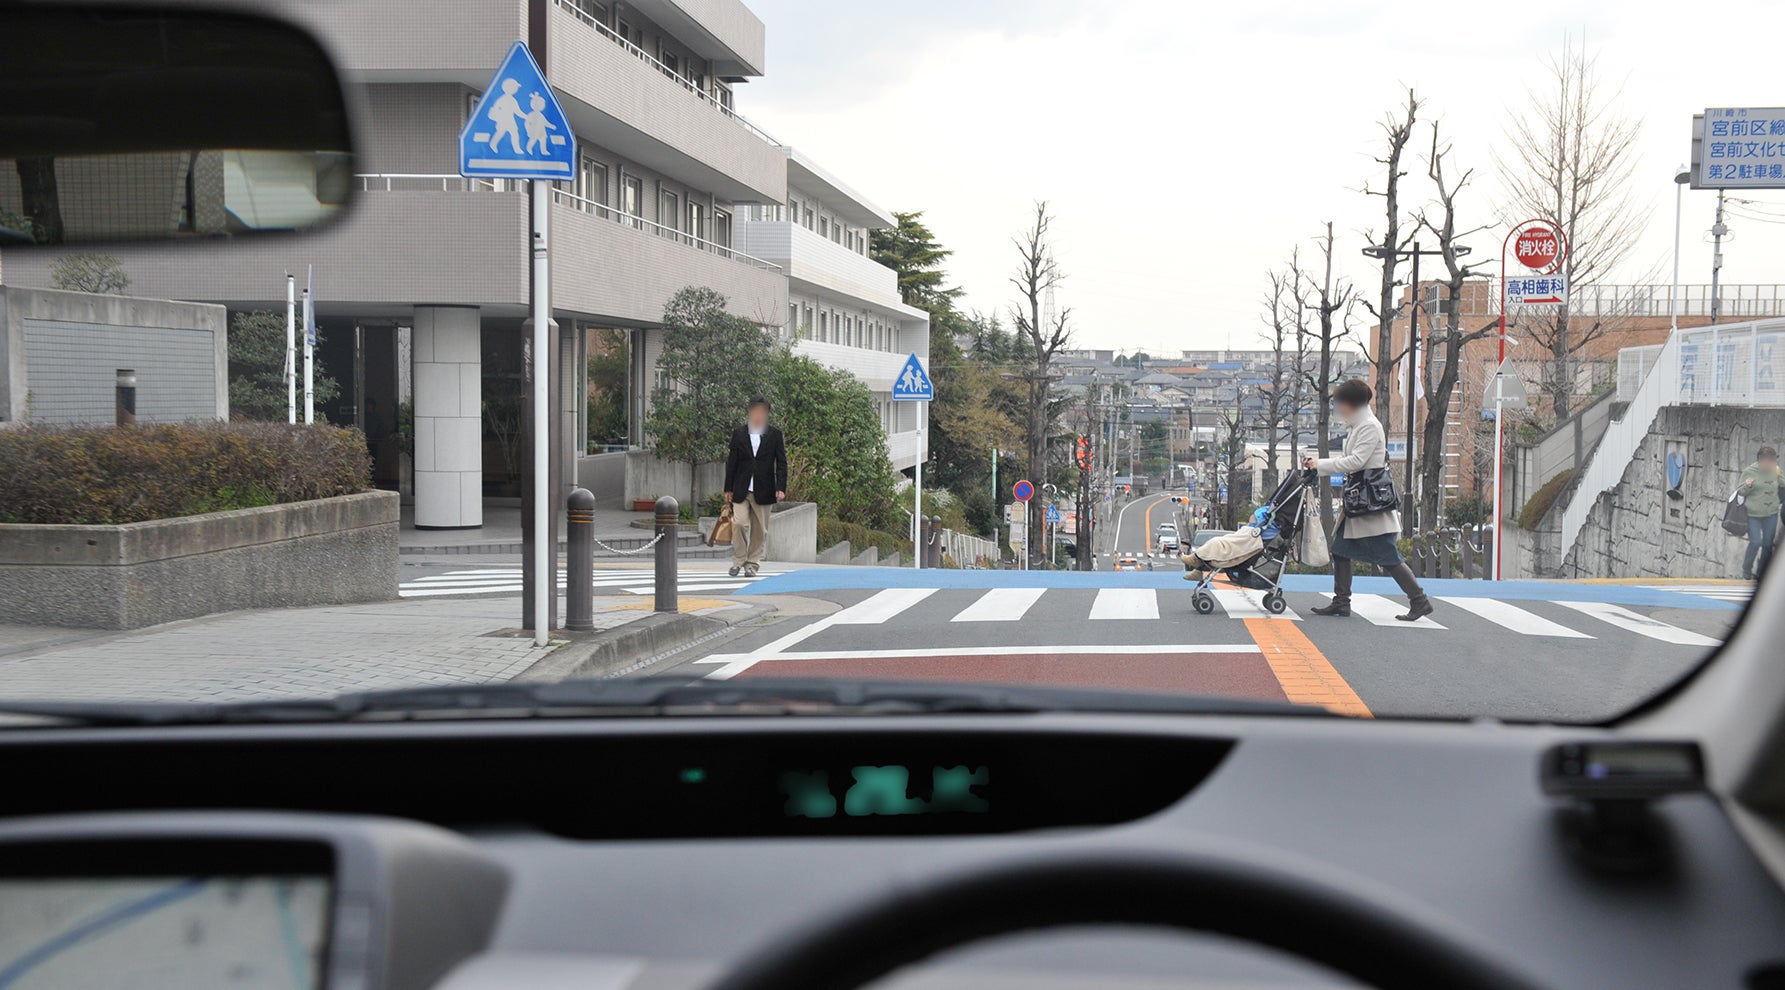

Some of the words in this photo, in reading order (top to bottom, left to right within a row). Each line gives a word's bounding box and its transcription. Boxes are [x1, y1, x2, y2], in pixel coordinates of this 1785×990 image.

[1708, 164, 1785, 179] 第2駐車場
[1519, 239, 1555, 256] 消火栓
[1508, 278, 1564, 295] 高相歯科
[1508, 296, 1523, 304] 入口
